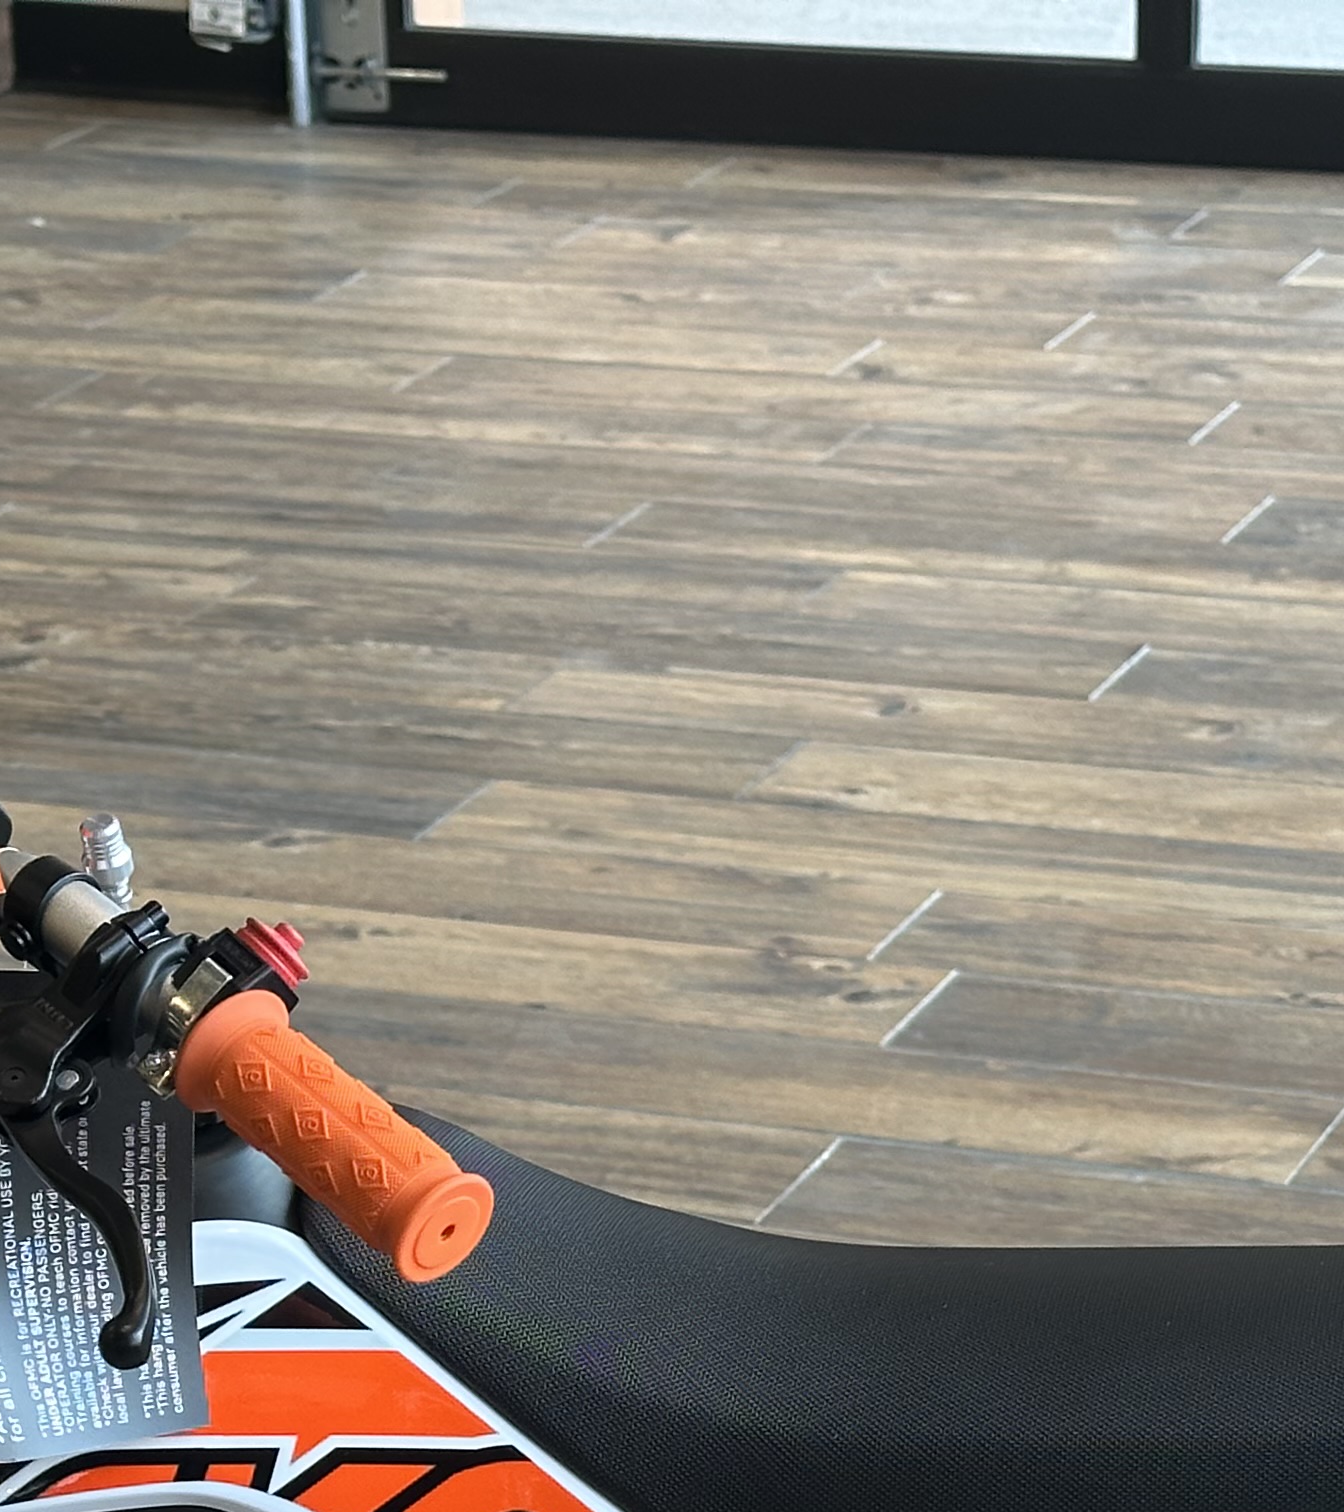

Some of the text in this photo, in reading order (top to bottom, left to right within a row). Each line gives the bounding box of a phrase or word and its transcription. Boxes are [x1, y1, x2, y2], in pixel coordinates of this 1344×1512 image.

[137, 1100, 151, 1144] ultimate
[76, 1130, 89, 1157] state
[139, 1146, 150, 1165] the
[121, 1150, 135, 1186] before
[138, 1167, 154, 1181] by
[0, 1180, 14, 1208] USE
[138, 1184, 151, 1234] removed
[154, 1183, 167, 1212] been
[48, 1212, 62, 1254] OFMC
[63, 1214, 78, 1264] contact
[79, 1222, 92, 1247] find
[154, 1215, 166, 1237] has
[2, 1210, 27, 1317] RECREATIONAL
[50, 1256, 66, 1294] teach
[82, 1251, 93, 1265] to
[95, 1248, 110, 1290] OFMC
[154, 1240, 168, 1284] vehicle
[57, 1297, 68, 1311] to
[82, 1268, 97, 1309] dealer
[158, 1287, 170, 1310] the
[69, 1268, 87, 1345] information
[17, 1320, 30, 1340] for
[60, 1315, 77, 1368] courses
[89, 1312, 101, 1343] your
[161, 1312, 174, 1344] after
[20, 1343, 33, 1355] is
[33, 1339, 53, 1384] ADULT
[77, 1349, 91, 1367] for
[151, 1344, 164, 1378] hang
[23, 1358, 42, 1401] OFMC
[166, 1348, 184, 1414] consumer
[43, 1386, 64, 1437] UNDER
[83, 1371, 103, 1429] available
[114, 1393, 129, 1424] local
[7, 1416, 26, 1442] for
